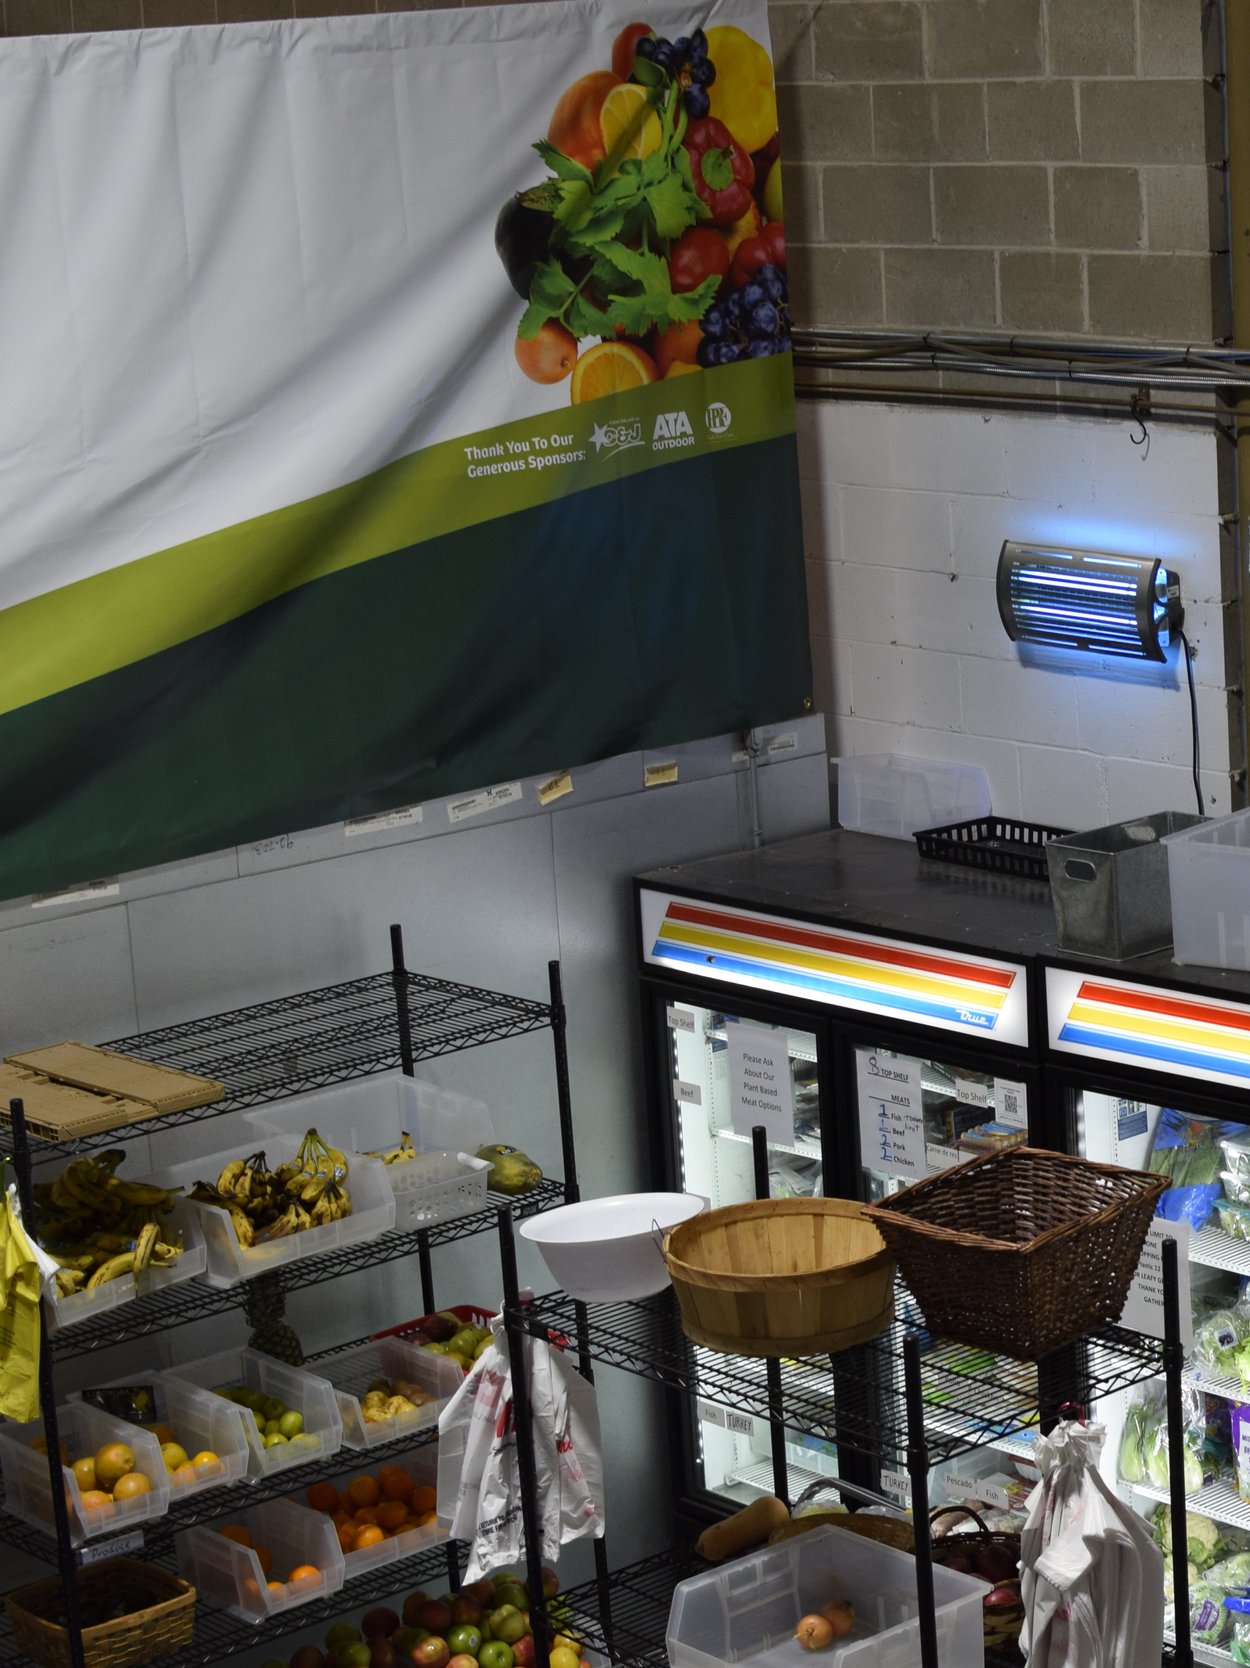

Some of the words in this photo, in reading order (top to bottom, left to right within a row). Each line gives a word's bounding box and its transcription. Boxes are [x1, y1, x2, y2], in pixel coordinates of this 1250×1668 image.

[652, 411, 694, 440] ATA
[464, 445, 504, 461] Thank
[505, 440, 530, 456] You
[531, 437, 548, 452] To
[549, 433, 574, 449] Our
[652, 436, 695, 451] OUTDOOR
[467, 457, 527, 478] Generous
[528, 450, 586, 471] Sponsors:
[668, 1015, 680, 1026] Top
[743, 1053, 762, 1065] Please
[763, 1058, 774, 1066] Ask
[744, 1067, 762, 1079] About
[763, 1072, 775, 1081] Our
[881, 1068, 892, 1077] TOP
[893, 1071, 909, 1081] SHELF
[680, 1087, 694, 1098] Beef
[743, 1082, 759, 1093] Plant
[760, 1085, 778, 1097] Based
[891, 1094, 910, 1105] MEATS
[956, 1089, 969, 1101] Top
[970, 1092, 987, 1104] Shelf
[741, 1095, 757, 1107] Meat
[758, 1100, 782, 1112] Options
[891, 1113, 902, 1122] Fish
[892, 1128, 905, 1137] Beef
[893, 1142, 905, 1151] Pork
[893, 1156, 914, 1167] Chicken
[1150, 1230, 1164, 1239] LIMIT
[1140, 1251, 1160, 1261] OPPING
[1141, 1273, 1157, 1282] LEAFY
[1138, 1283, 1156, 1293] THANK
[726, 1413, 753, 1431] TURKEY
[883, 1475, 909, 1491] TURKEY
[946, 1475, 973, 1489] Pescado
[986, 1489, 999, 1500] Fish
